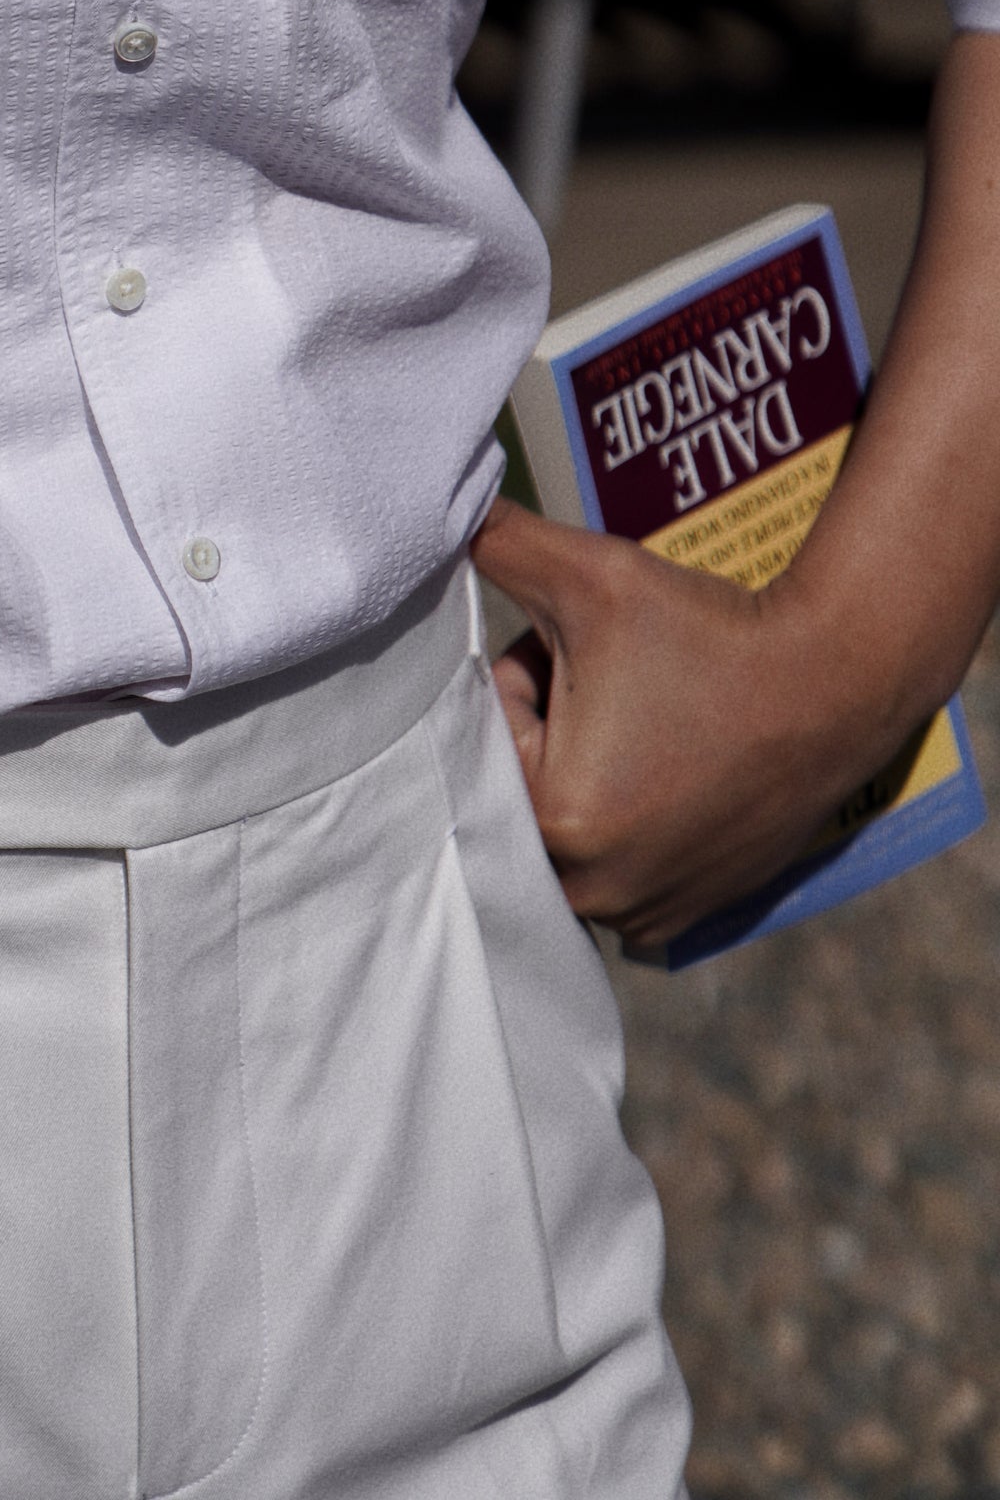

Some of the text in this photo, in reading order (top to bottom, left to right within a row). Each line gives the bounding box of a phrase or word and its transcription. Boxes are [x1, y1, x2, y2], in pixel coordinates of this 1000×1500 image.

[591, 285, 831, 472] CARNEGIE
[658, 380, 804, 513] DALE
[667, 455, 830, 559] IN A CHANGING WORLD
[741, 510, 793, 551] PEOPLE
[711, 541, 739, 568] AND
[758, 547, 788, 577] WIN
